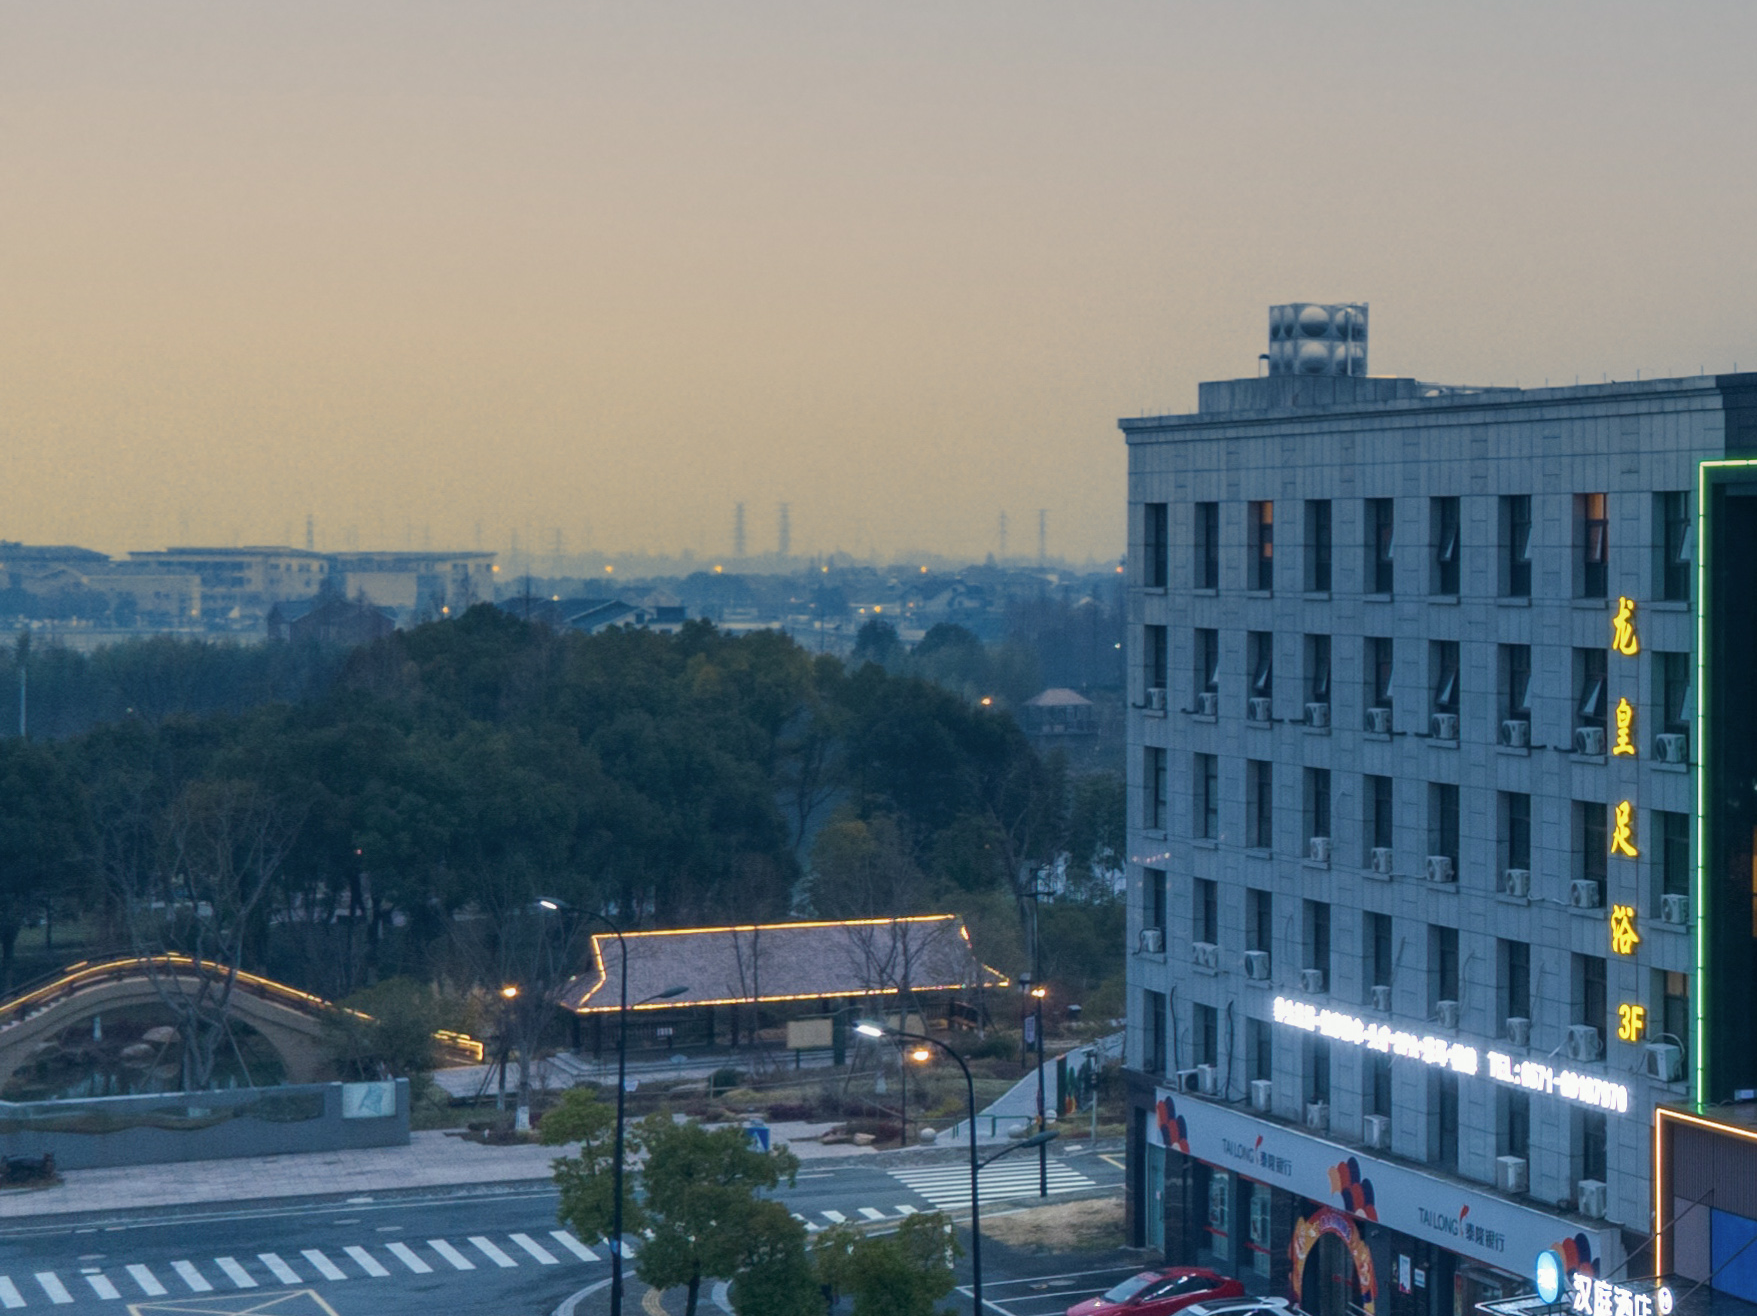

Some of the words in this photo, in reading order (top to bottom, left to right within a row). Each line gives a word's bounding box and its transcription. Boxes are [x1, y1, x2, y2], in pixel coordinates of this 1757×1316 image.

[1610, 596, 1640, 955] 龙皇足浴
[1617, 1003, 1645, 1042] 3F
[1418, 1207, 1458, 1236] TAILONG
[1465, 1223, 1505, 1252] 泰隆银行
